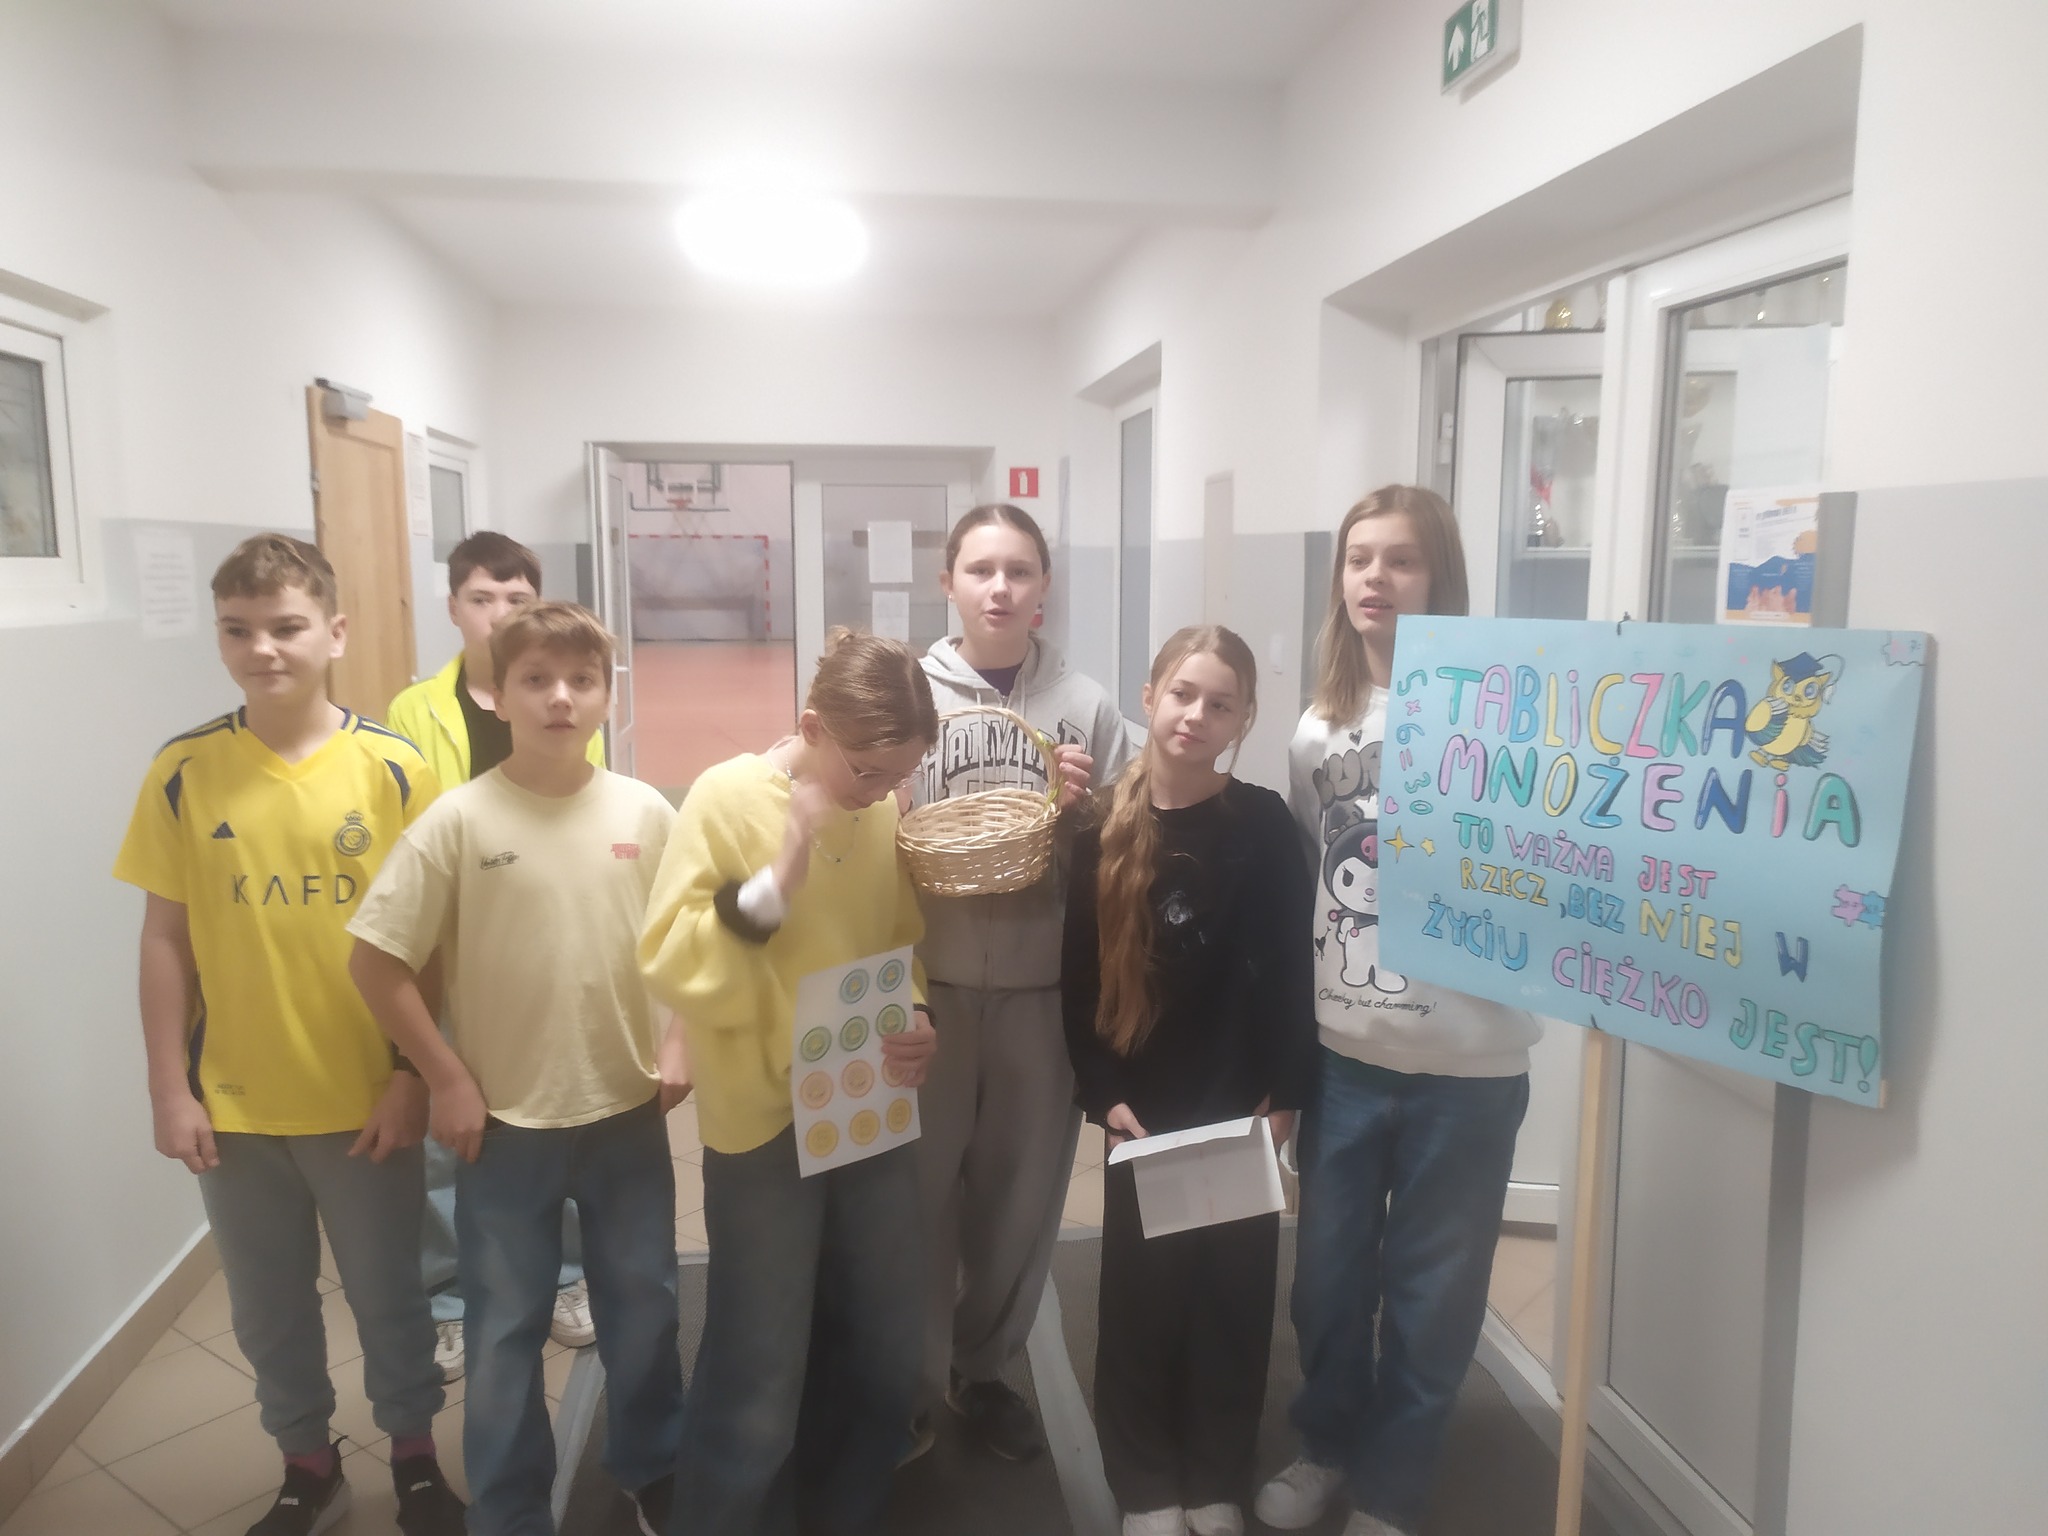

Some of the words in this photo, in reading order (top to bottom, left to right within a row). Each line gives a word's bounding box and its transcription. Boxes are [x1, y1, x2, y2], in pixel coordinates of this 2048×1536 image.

[233, 874, 357, 905] KAFD
[1452, 812, 1494, 854] TO
[1504, 825, 1615, 882] WAŻNA
[1638, 854, 1717, 899] JEST
[1460, 857, 1548, 908] RZECZ
[1775, 931, 1809, 983] W
[1358, 995, 1372, 1008] but
[1728, 998, 1879, 1093] JEST!
